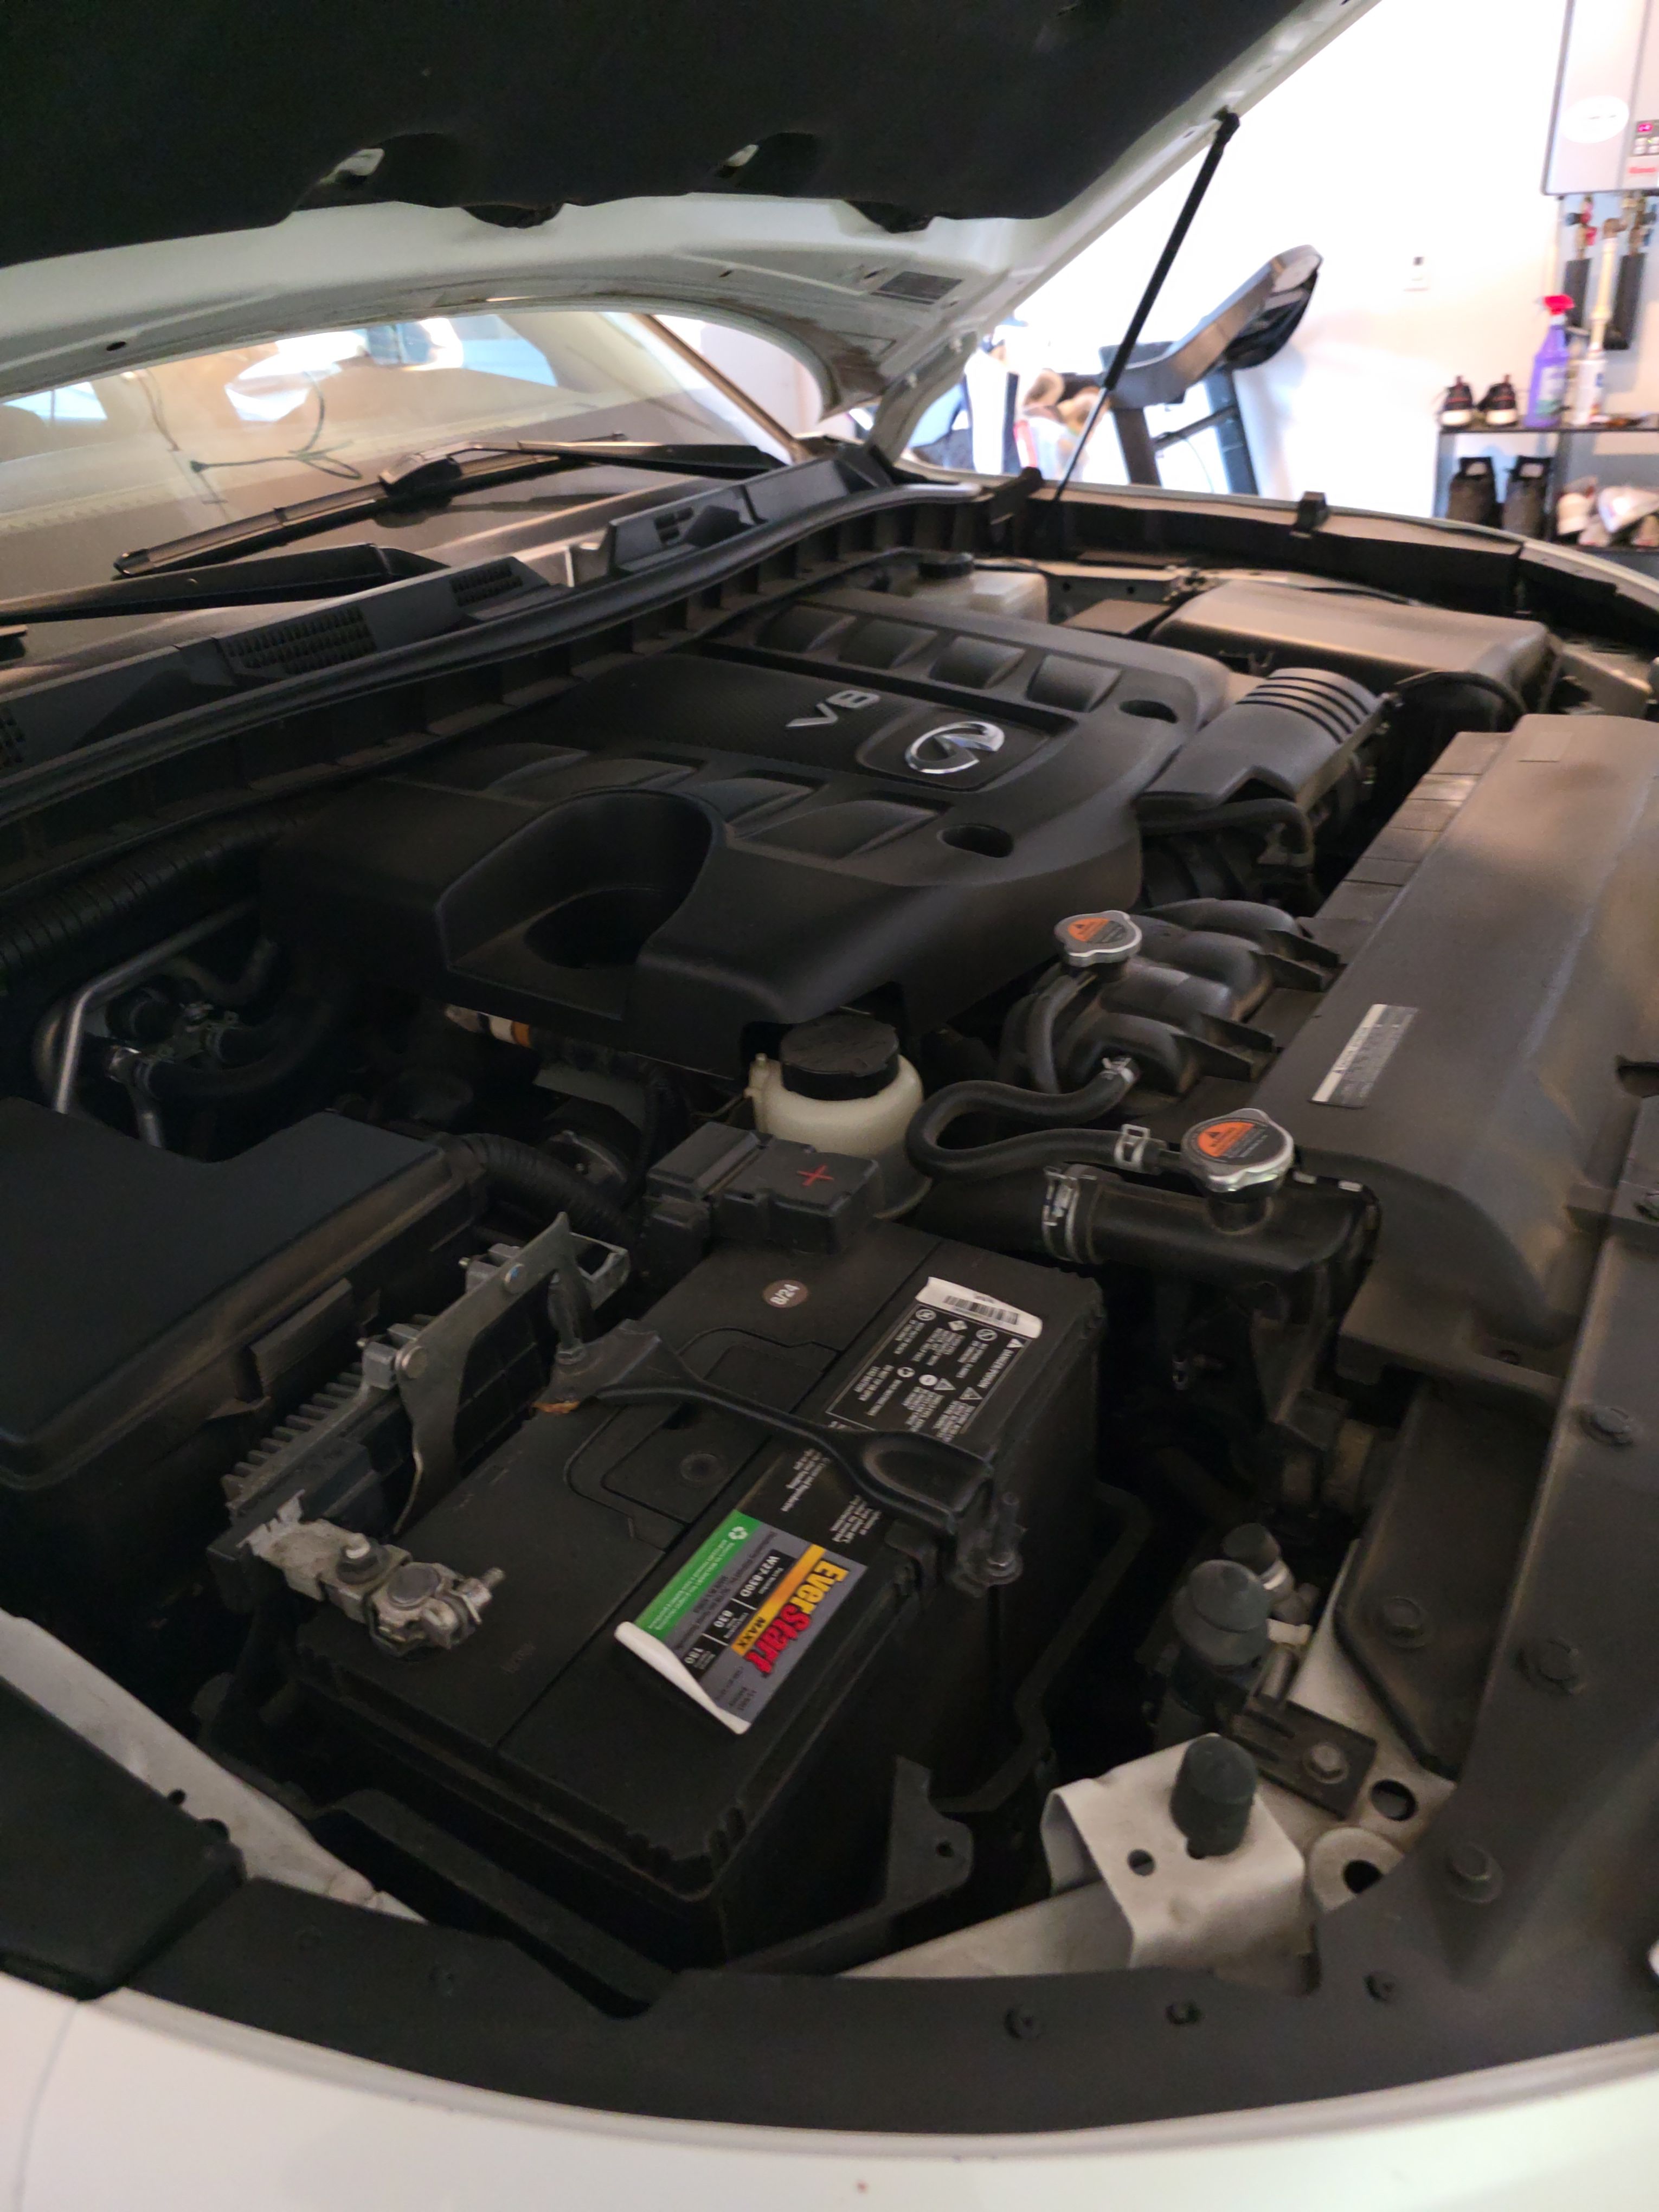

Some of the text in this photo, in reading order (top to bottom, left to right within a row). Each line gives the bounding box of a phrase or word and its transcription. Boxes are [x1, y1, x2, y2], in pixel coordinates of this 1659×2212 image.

[786, 690, 879, 728] V8
[737, 1616, 767, 1649] MAXX
[744, 1559, 849, 1675] EverStart
